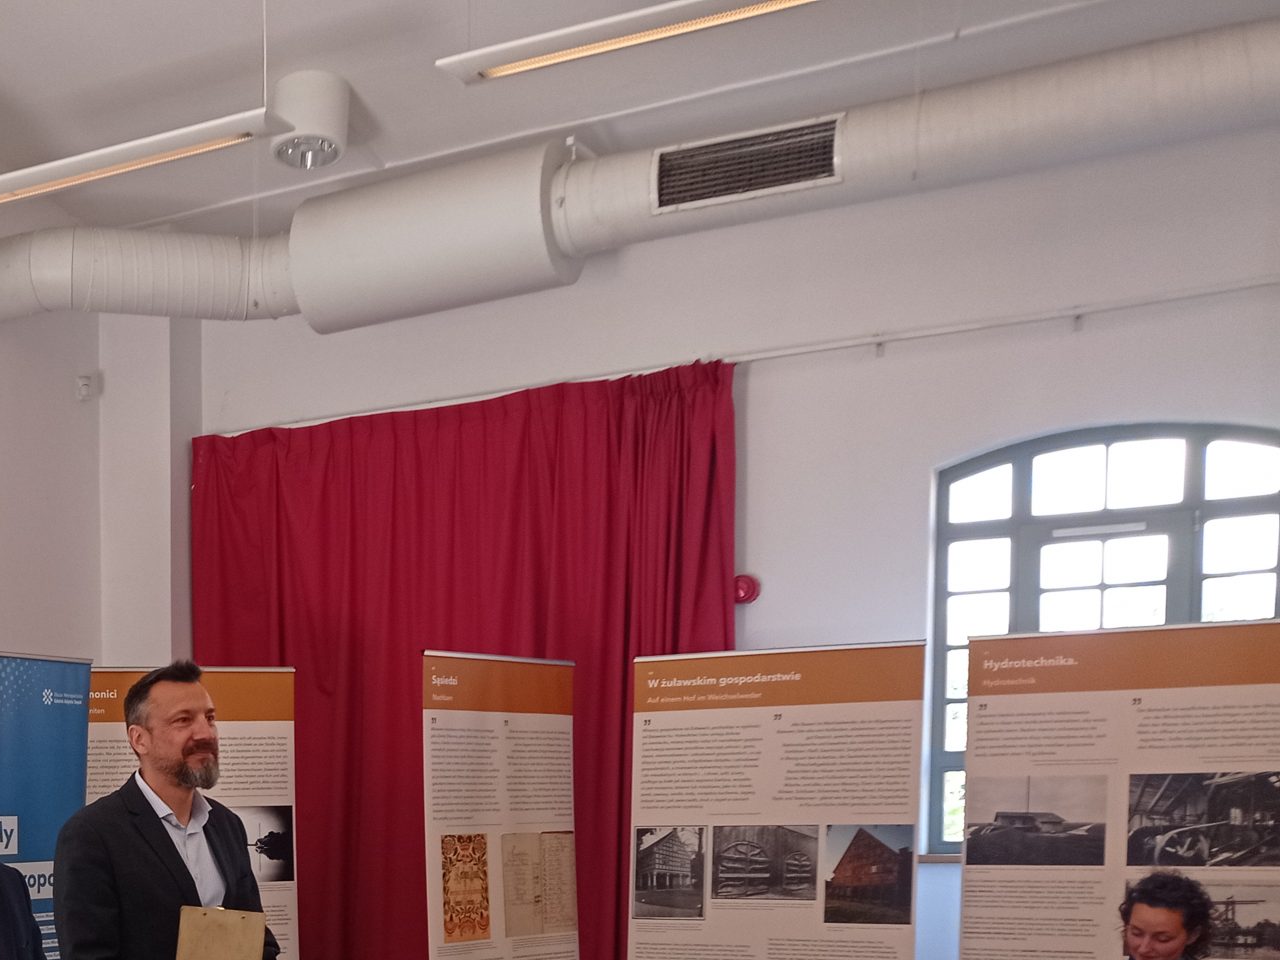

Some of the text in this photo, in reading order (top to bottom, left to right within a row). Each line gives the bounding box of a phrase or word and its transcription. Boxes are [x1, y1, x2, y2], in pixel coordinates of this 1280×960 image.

[983, 656, 1079, 672] Hydrotechnika.
[648, 679, 658, 688] W
[719, 671, 802, 687] gospodarstwie
